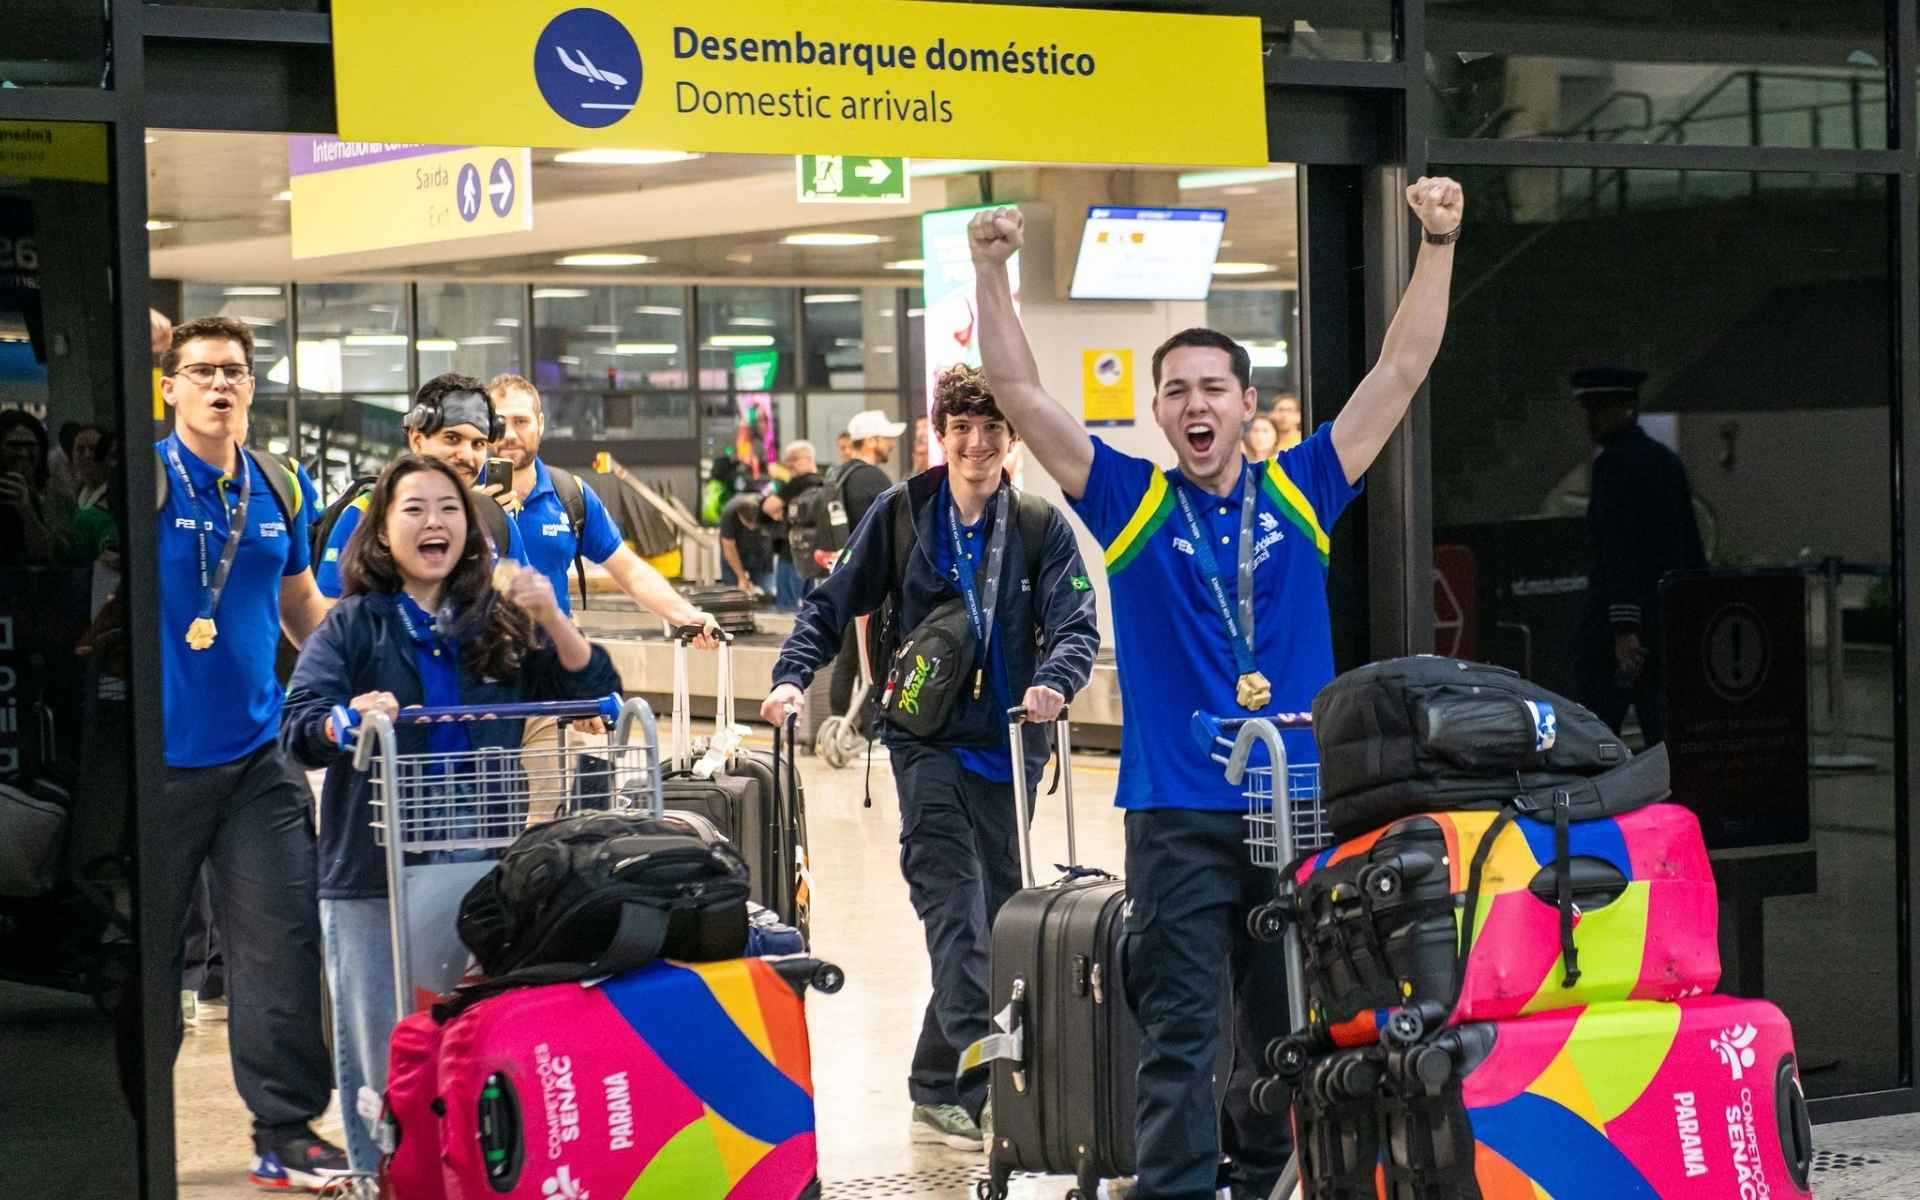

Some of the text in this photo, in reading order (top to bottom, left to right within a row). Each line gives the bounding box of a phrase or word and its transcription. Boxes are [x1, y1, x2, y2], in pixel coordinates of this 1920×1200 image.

[673, 26, 1096, 77] Desembarque doméstico
[675, 81, 953, 123] Domestic arrivals
[551, 1055, 580, 1143] SENAC
[1725, 1104, 1757, 1200] SENAC
